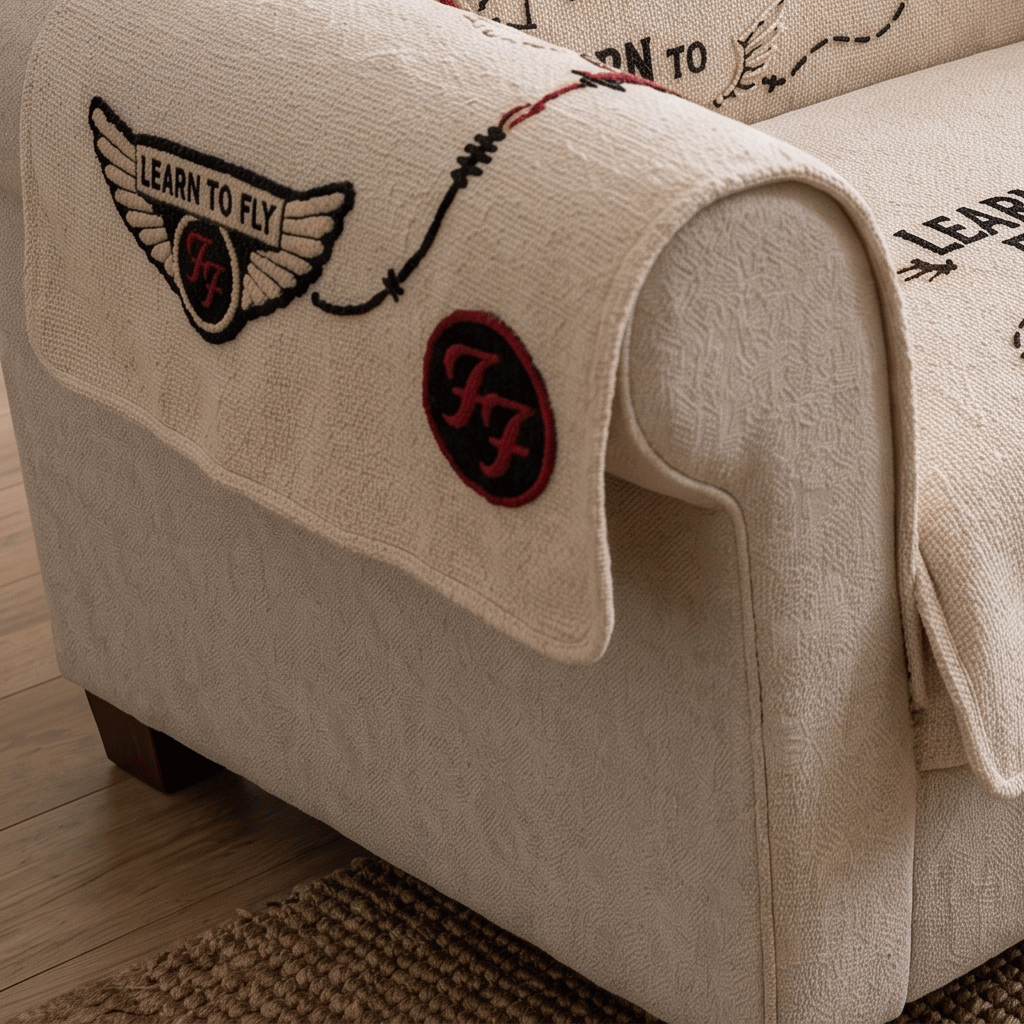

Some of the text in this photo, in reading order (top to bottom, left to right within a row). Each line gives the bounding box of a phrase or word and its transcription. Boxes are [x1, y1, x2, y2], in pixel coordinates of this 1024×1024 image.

[666, 41, 707, 79] TO
[141, 155, 276, 235] LEARN TO FLY
[186, 231, 226, 308] FF
[443, 343, 537, 479] FF
